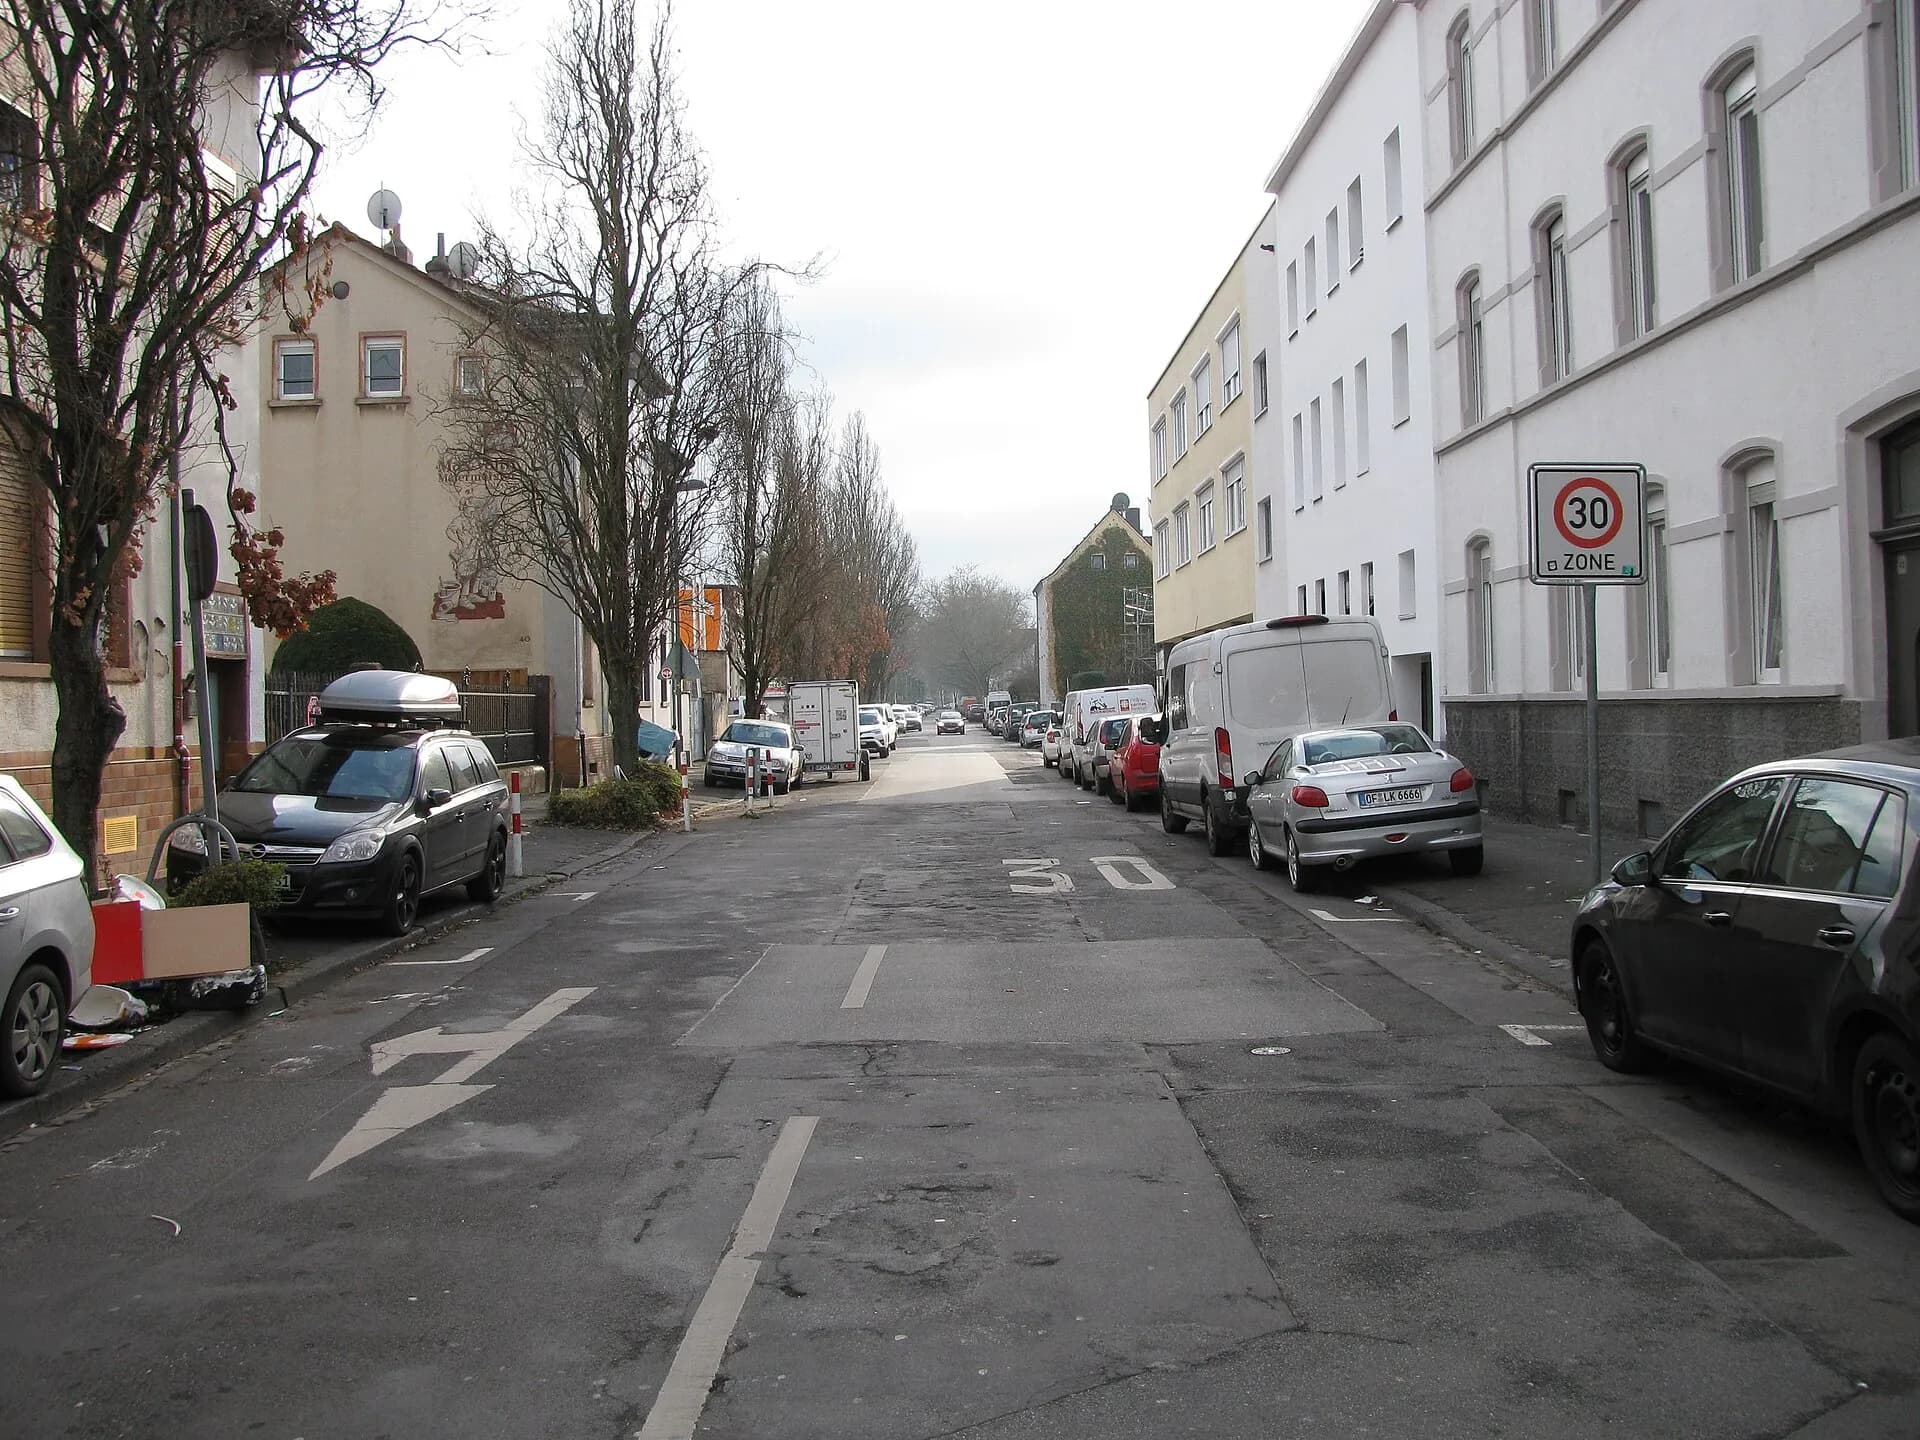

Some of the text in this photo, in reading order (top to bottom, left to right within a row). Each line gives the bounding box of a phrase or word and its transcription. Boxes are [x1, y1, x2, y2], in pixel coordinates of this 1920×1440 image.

[1568, 497, 1608, 529] 30
[1563, 553, 1616, 571] ZONE
[1365, 789, 1420, 804] OF LK 6666
[1001, 855, 1177, 894] 30
